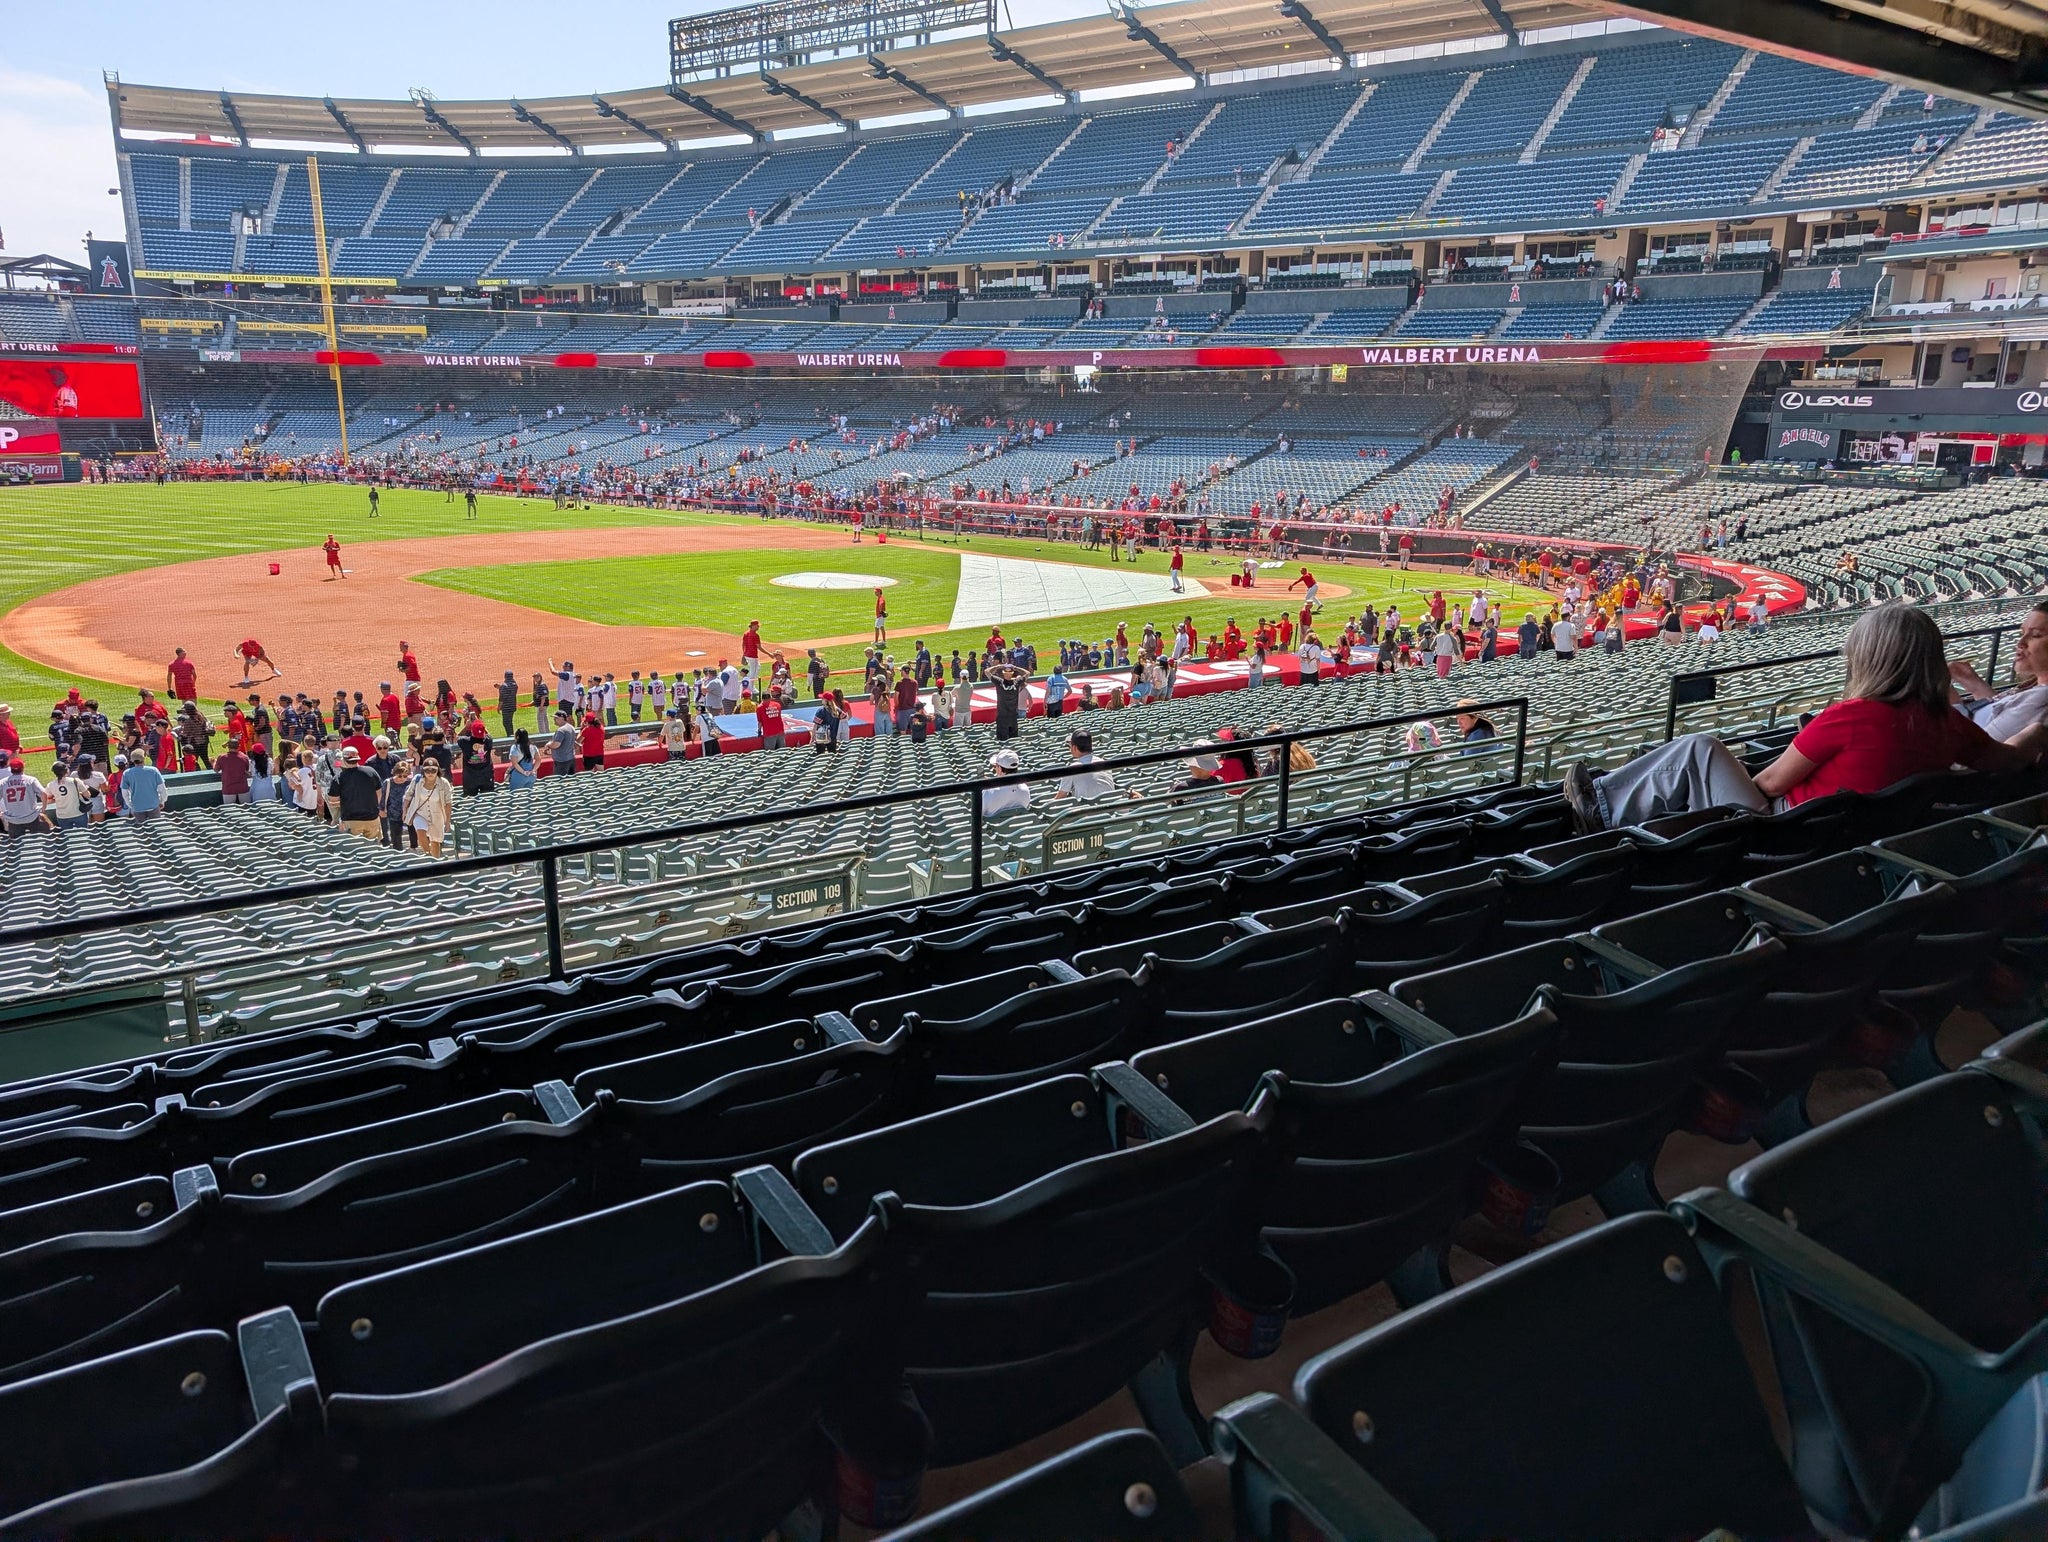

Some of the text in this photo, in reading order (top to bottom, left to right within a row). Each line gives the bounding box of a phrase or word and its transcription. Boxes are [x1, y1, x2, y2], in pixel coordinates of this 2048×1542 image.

[0, 343, 58, 352] RT URENA
[424, 355, 521, 366] WALBERT URENA
[644, 355, 654, 365] 57
[797, 354, 901, 365] WALBERT URENA
[1093, 352, 1102, 364] P
[1363, 347, 1540, 363] WALBERT URENA
[1805, 395, 1873, 406] LEXUS
[1778, 428, 1831, 448] ANGELS
[676, 687, 686, 696] 24
[940, 697, 947, 706] 9
[6, 786, 27, 803] 27
[59, 785, 68, 796] 9
[1052, 833, 1103, 855] SECTION 110
[776, 883, 841, 909] SECTION 109
